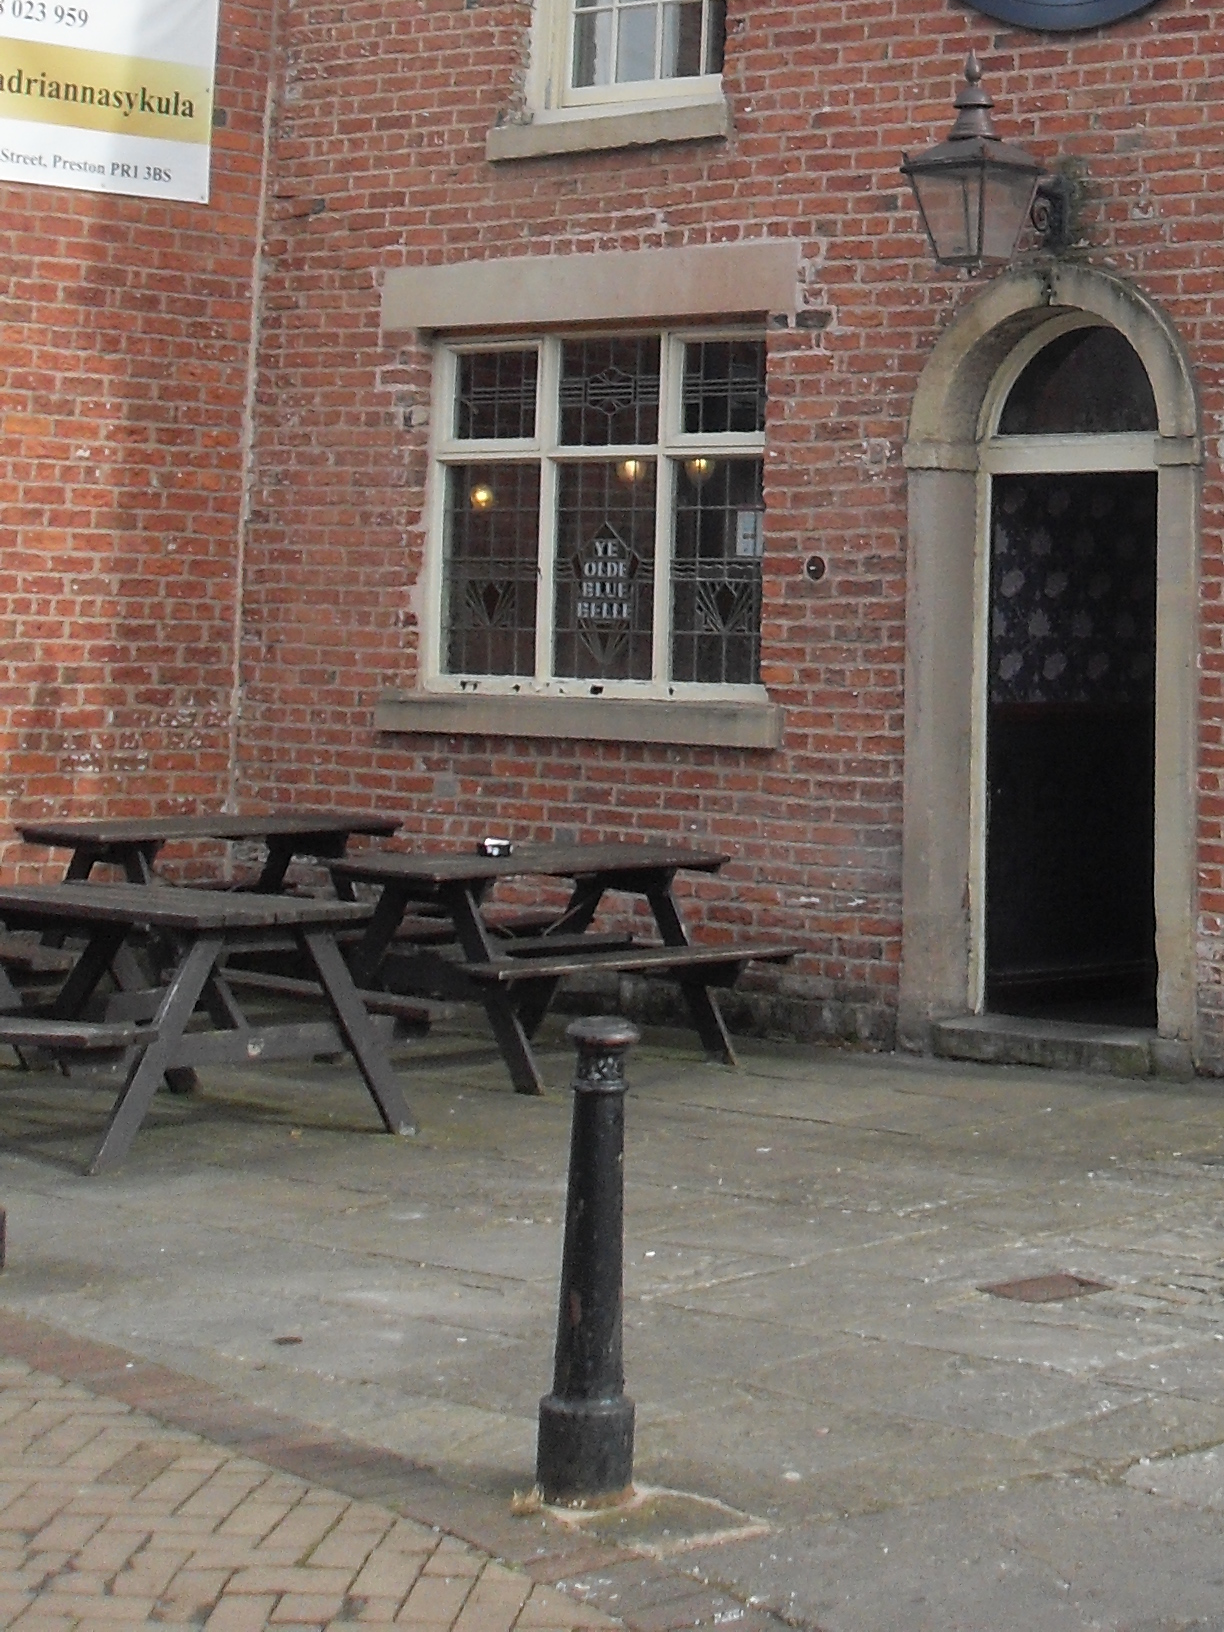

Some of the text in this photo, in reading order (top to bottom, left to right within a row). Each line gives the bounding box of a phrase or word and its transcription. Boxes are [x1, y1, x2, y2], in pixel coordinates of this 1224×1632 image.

[12, 0, 46, 22] 023
[54, 5, 89, 27] 959
[52, 155, 106, 176] Preston
[110, 162, 138, 179] PR1
[143, 167, 172, 183] 3BS
[594, 541, 618, 557] YE
[583, 561, 628, 578] OLDE
[582, 581, 628, 598] BLUE
